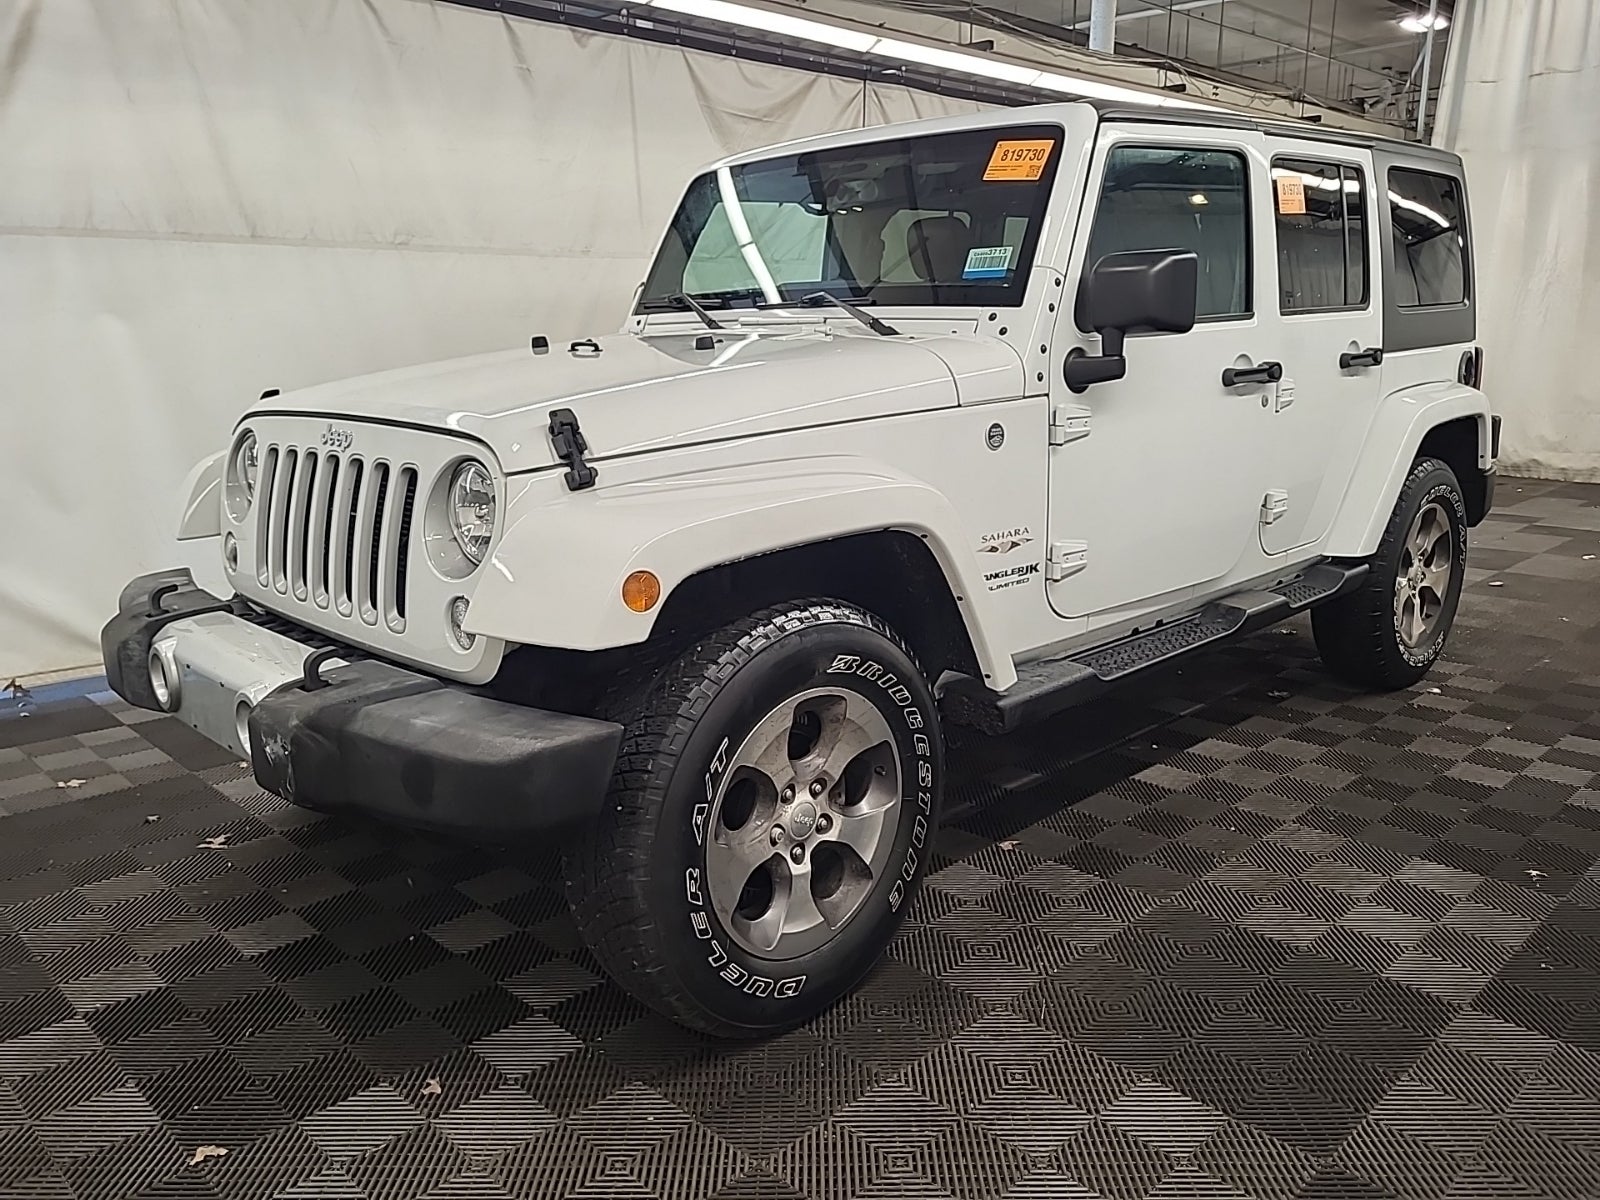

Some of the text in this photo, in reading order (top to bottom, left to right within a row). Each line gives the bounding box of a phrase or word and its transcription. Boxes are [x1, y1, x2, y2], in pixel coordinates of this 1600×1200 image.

[1000, 148, 1046, 162] 819730
[322, 423, 354, 453] Jeep
[981, 527, 1030, 544] SAHARA
[826, 654, 932, 913] BRIDGESTONE
[686, 867, 807, 999] DUELER
